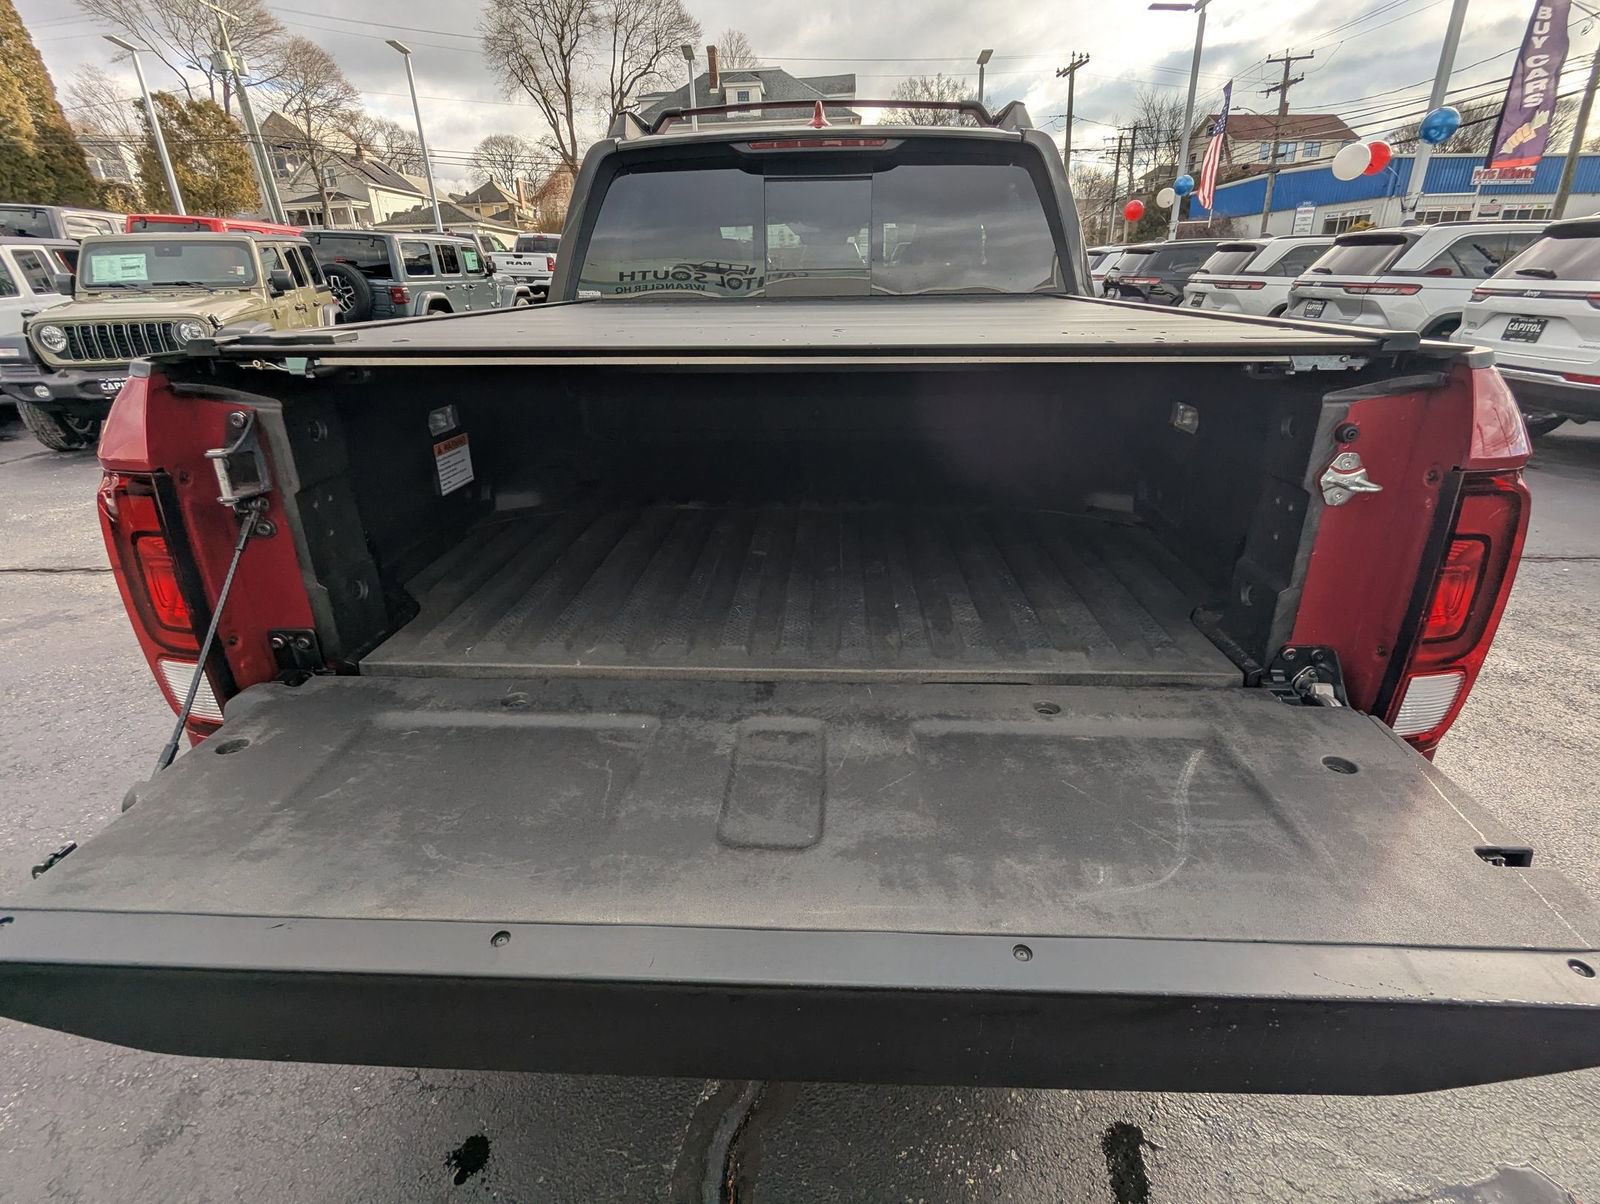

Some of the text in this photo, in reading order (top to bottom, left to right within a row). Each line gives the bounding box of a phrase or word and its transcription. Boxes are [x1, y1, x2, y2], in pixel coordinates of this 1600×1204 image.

[1523, 6, 1553, 108] BUY CARS
[1523, 290, 1541, 298] Jeep
[1507, 322, 1542, 333] CAPITOL
